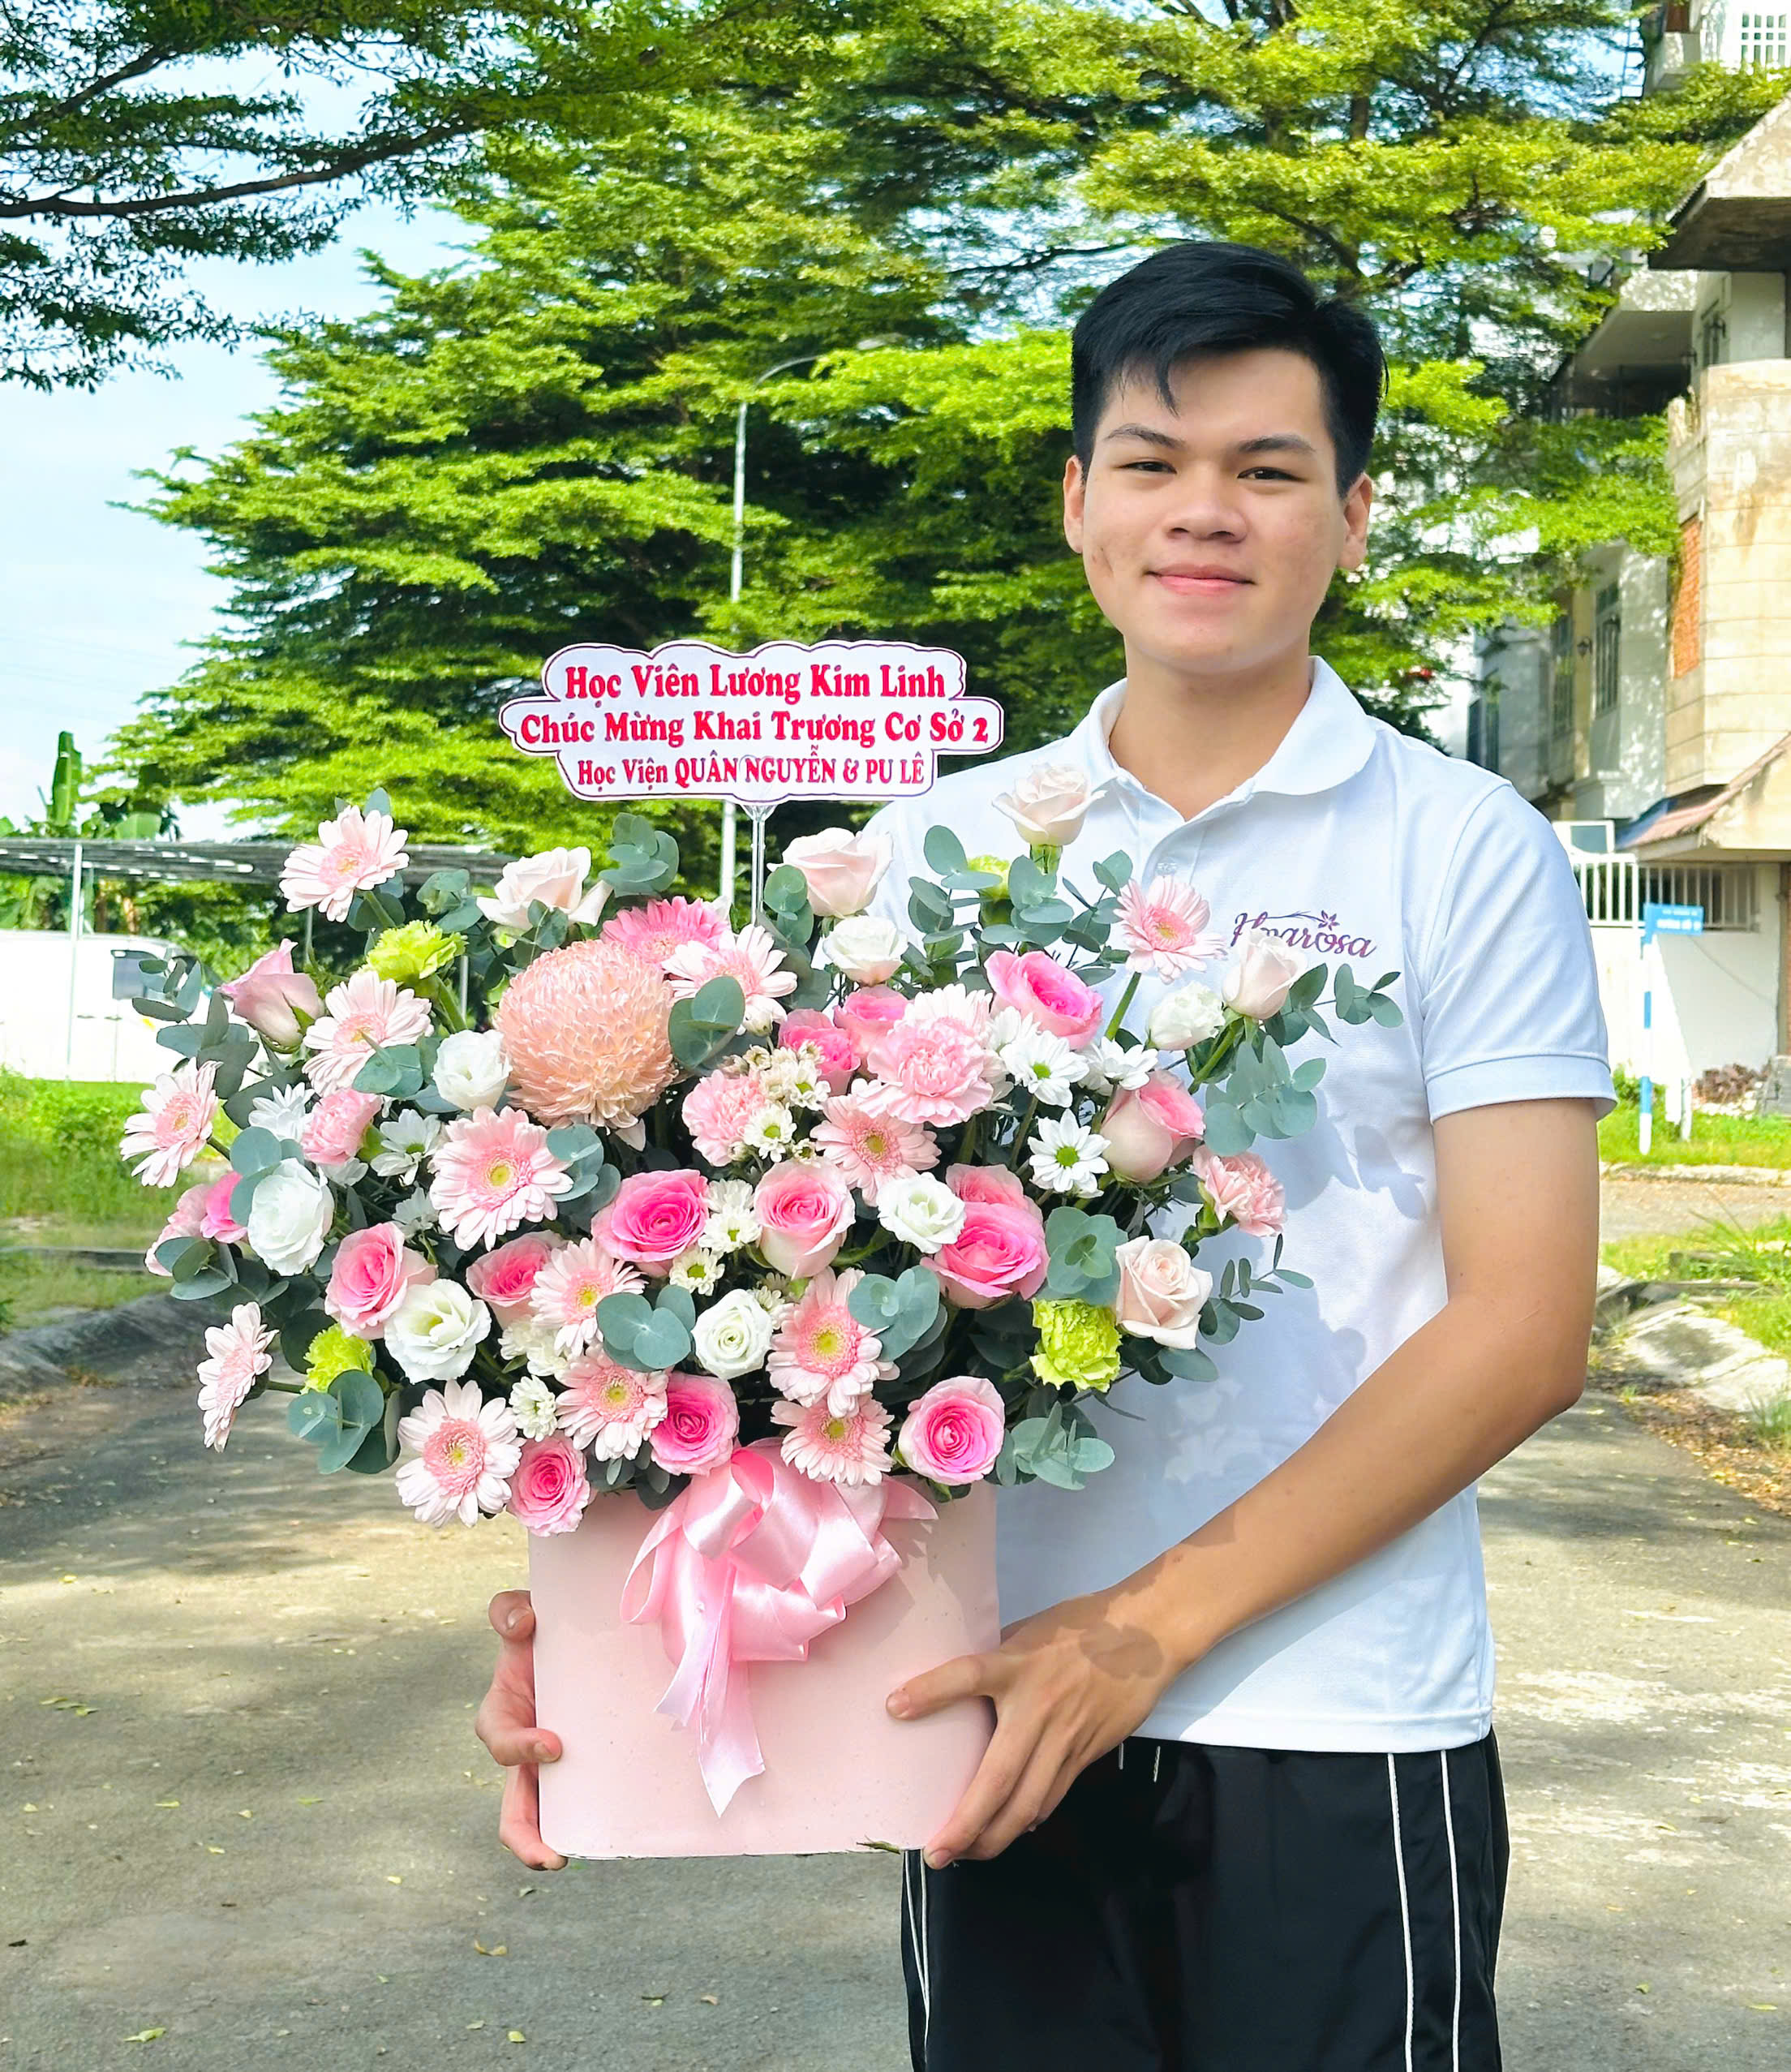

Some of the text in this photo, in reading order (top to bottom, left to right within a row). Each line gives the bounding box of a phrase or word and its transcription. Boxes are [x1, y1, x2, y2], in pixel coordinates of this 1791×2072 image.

[565, 663, 947, 708] Học Viên Lương Kim Linh
[520, 707, 989, 749] Chúc Mừng Khai Trương Cơ Sở 2
[578, 744, 925, 792] Học Viện QUÂN NGUYỄN & PU LÊ
